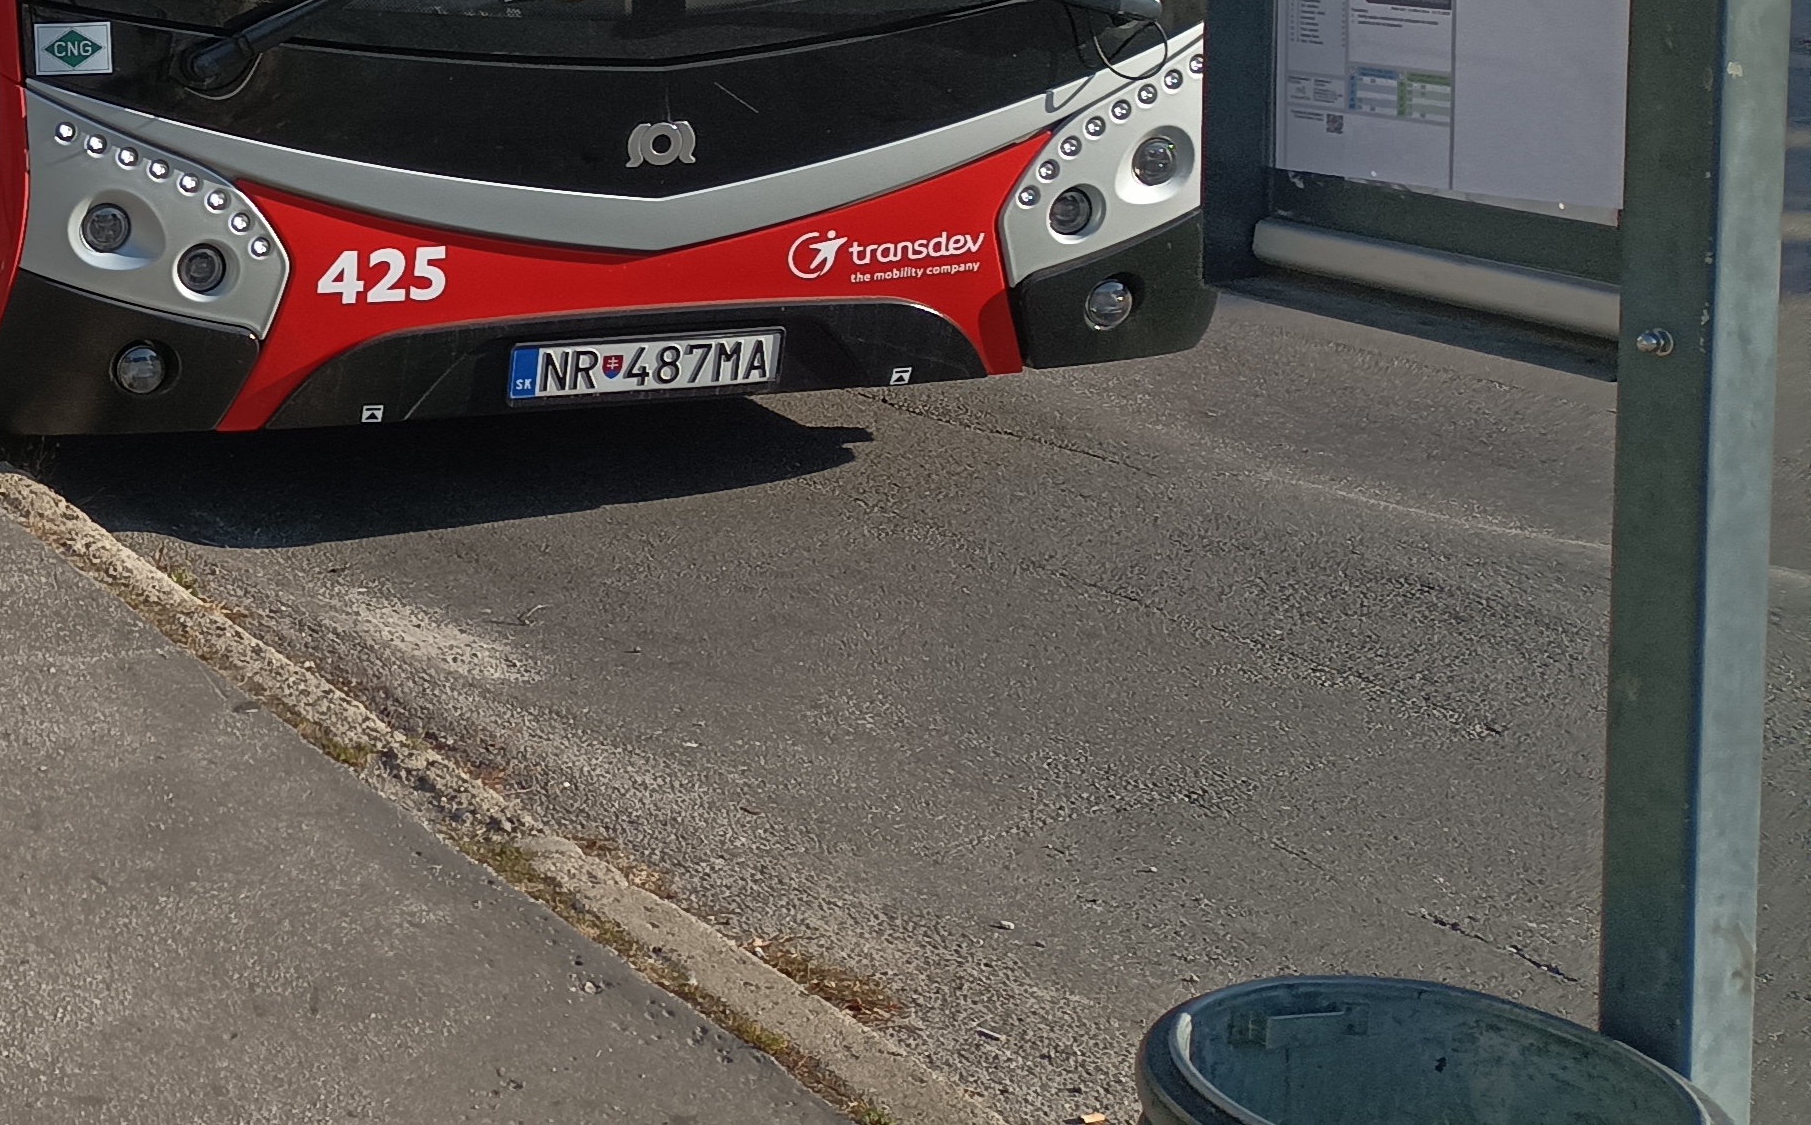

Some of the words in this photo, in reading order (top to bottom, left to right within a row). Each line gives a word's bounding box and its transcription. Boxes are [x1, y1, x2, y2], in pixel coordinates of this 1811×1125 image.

[53, 40, 92, 57] CNG
[848, 231, 985, 265] transdev
[316, 245, 447, 305] 425
[850, 273, 871, 283] the
[873, 267, 924, 281] mobility
[925, 261, 980, 275] company
[539, 349, 600, 393] NR
[622, 338, 768, 387] 487MA
[515, 378, 532, 390] SK
